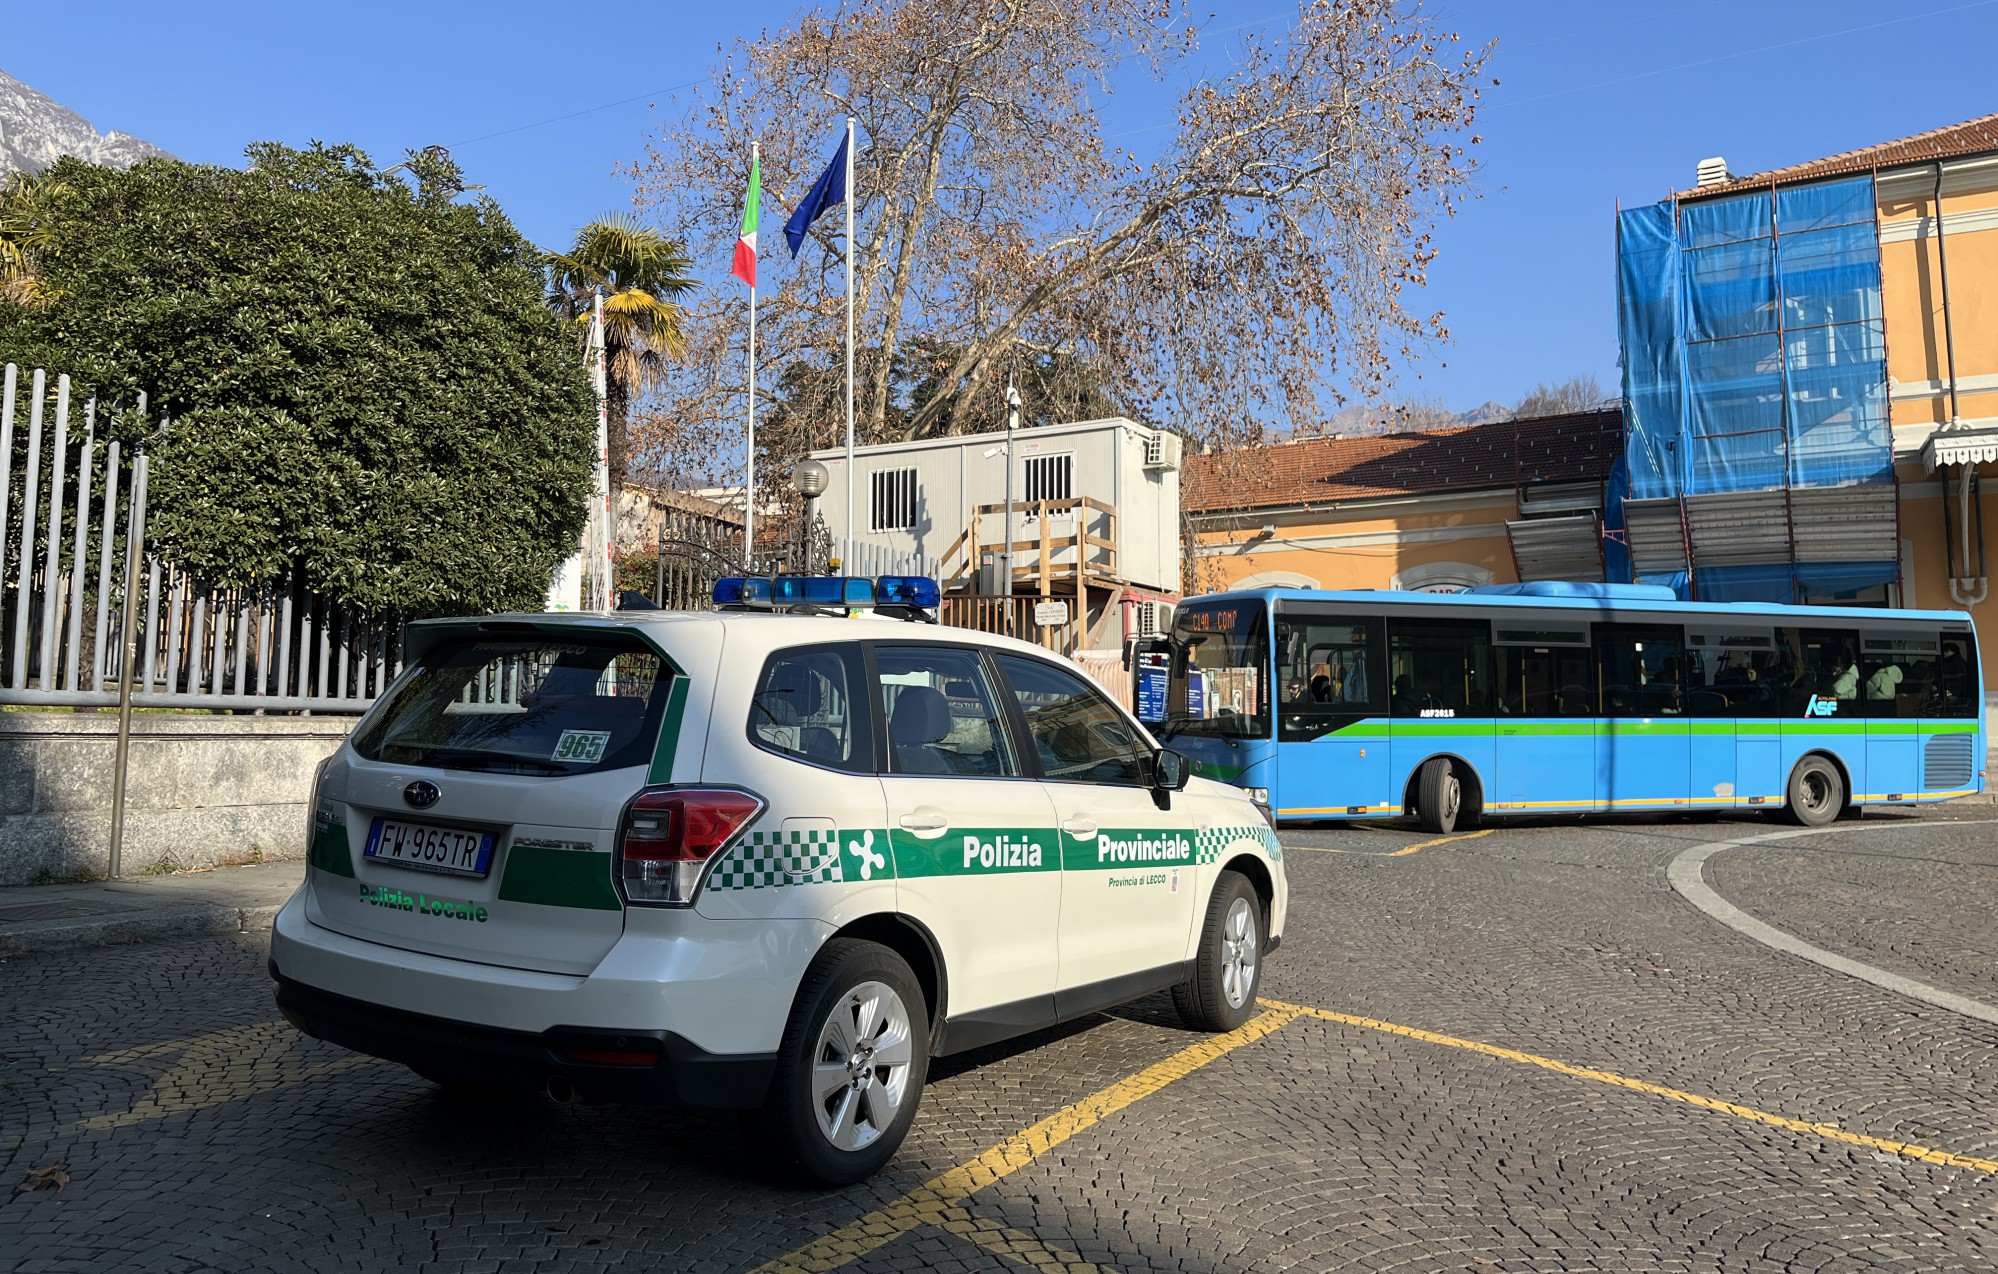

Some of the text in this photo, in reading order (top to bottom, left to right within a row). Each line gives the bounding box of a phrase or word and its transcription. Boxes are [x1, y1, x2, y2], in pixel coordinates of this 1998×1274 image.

[1193, 613, 1209, 631] C140
[558, 735, 604, 759] 965
[380, 825, 408, 857] FW
[411, 828, 477, 868] 965TR
[513, 837, 594, 851] FORESTER
[963, 833, 1190, 868] Polizia Provinciale
[1109, 874, 1166, 887] Provincia di LECCO
[359, 883, 488, 922] Polizia Locale
